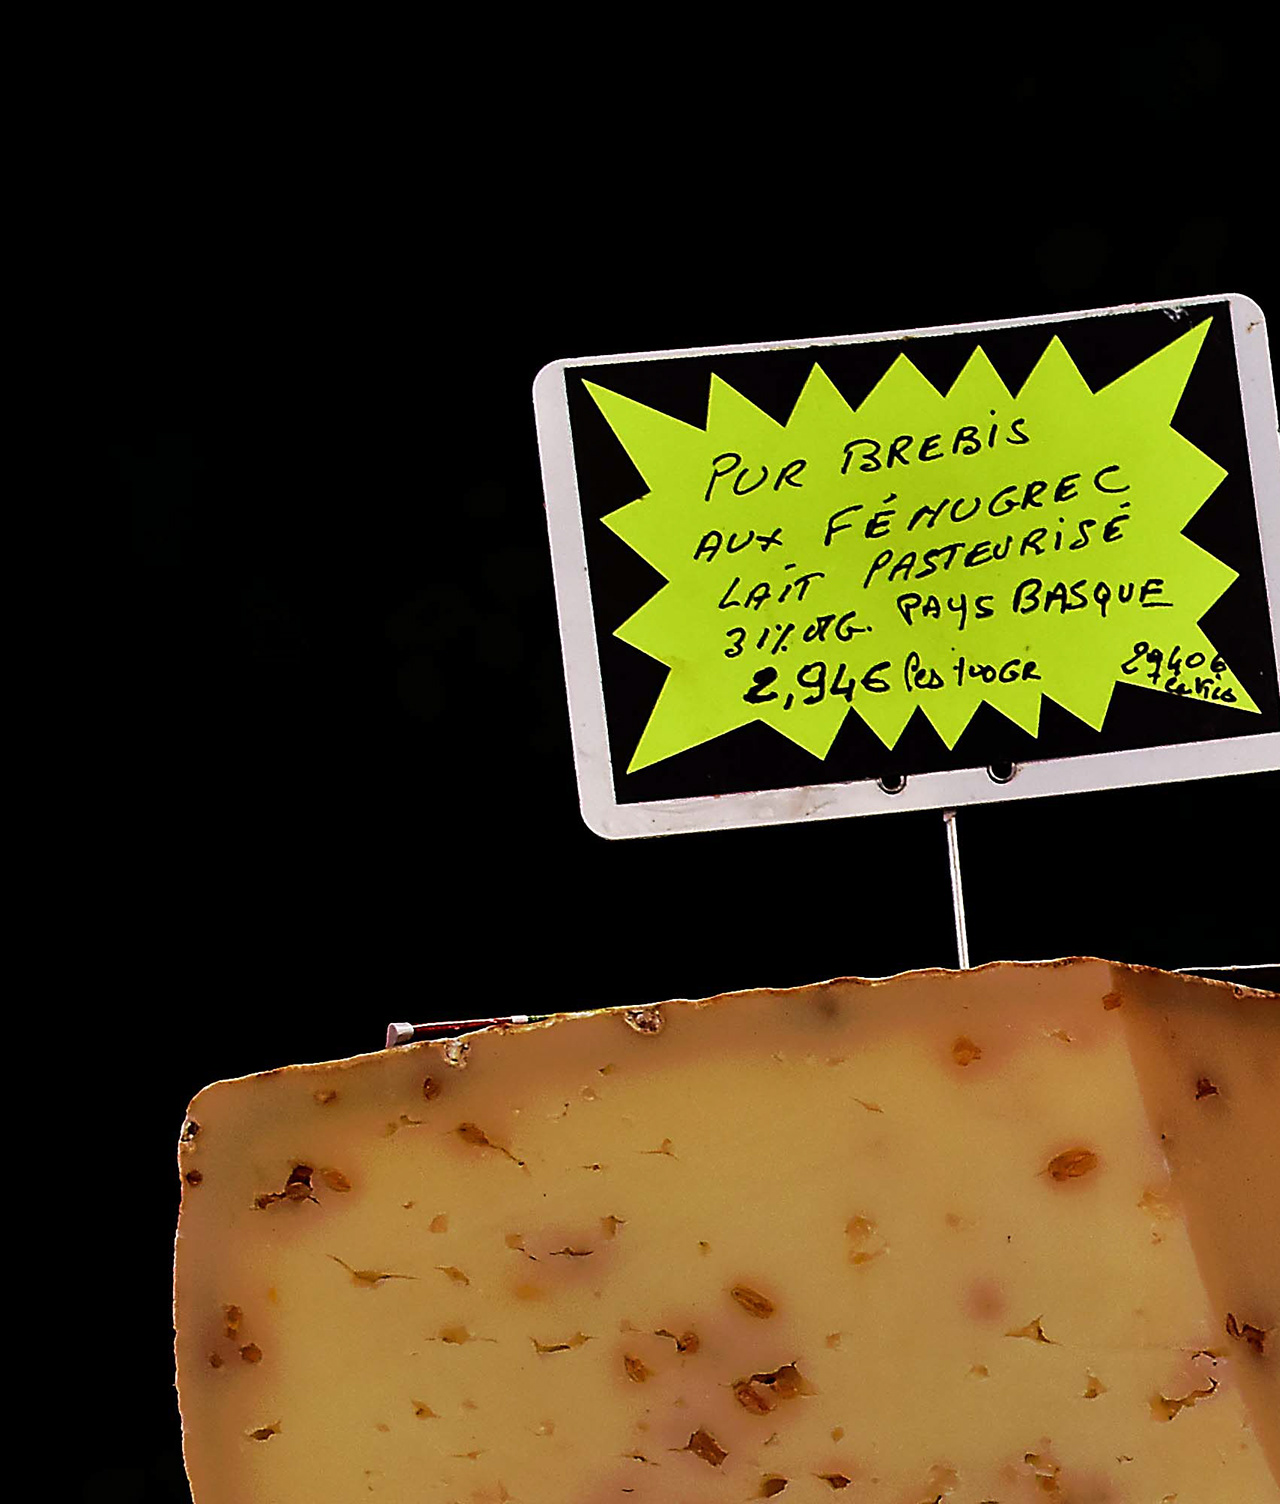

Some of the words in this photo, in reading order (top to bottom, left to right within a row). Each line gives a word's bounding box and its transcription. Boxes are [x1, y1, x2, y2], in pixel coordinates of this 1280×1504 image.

[704, 452, 807, 502] PUR
[693, 527, 783, 563] AUX
[896, 592, 994, 631] PAYS
[1012, 578, 1174, 618] BASQUE
[742, 661, 891, 711] 2,94€
